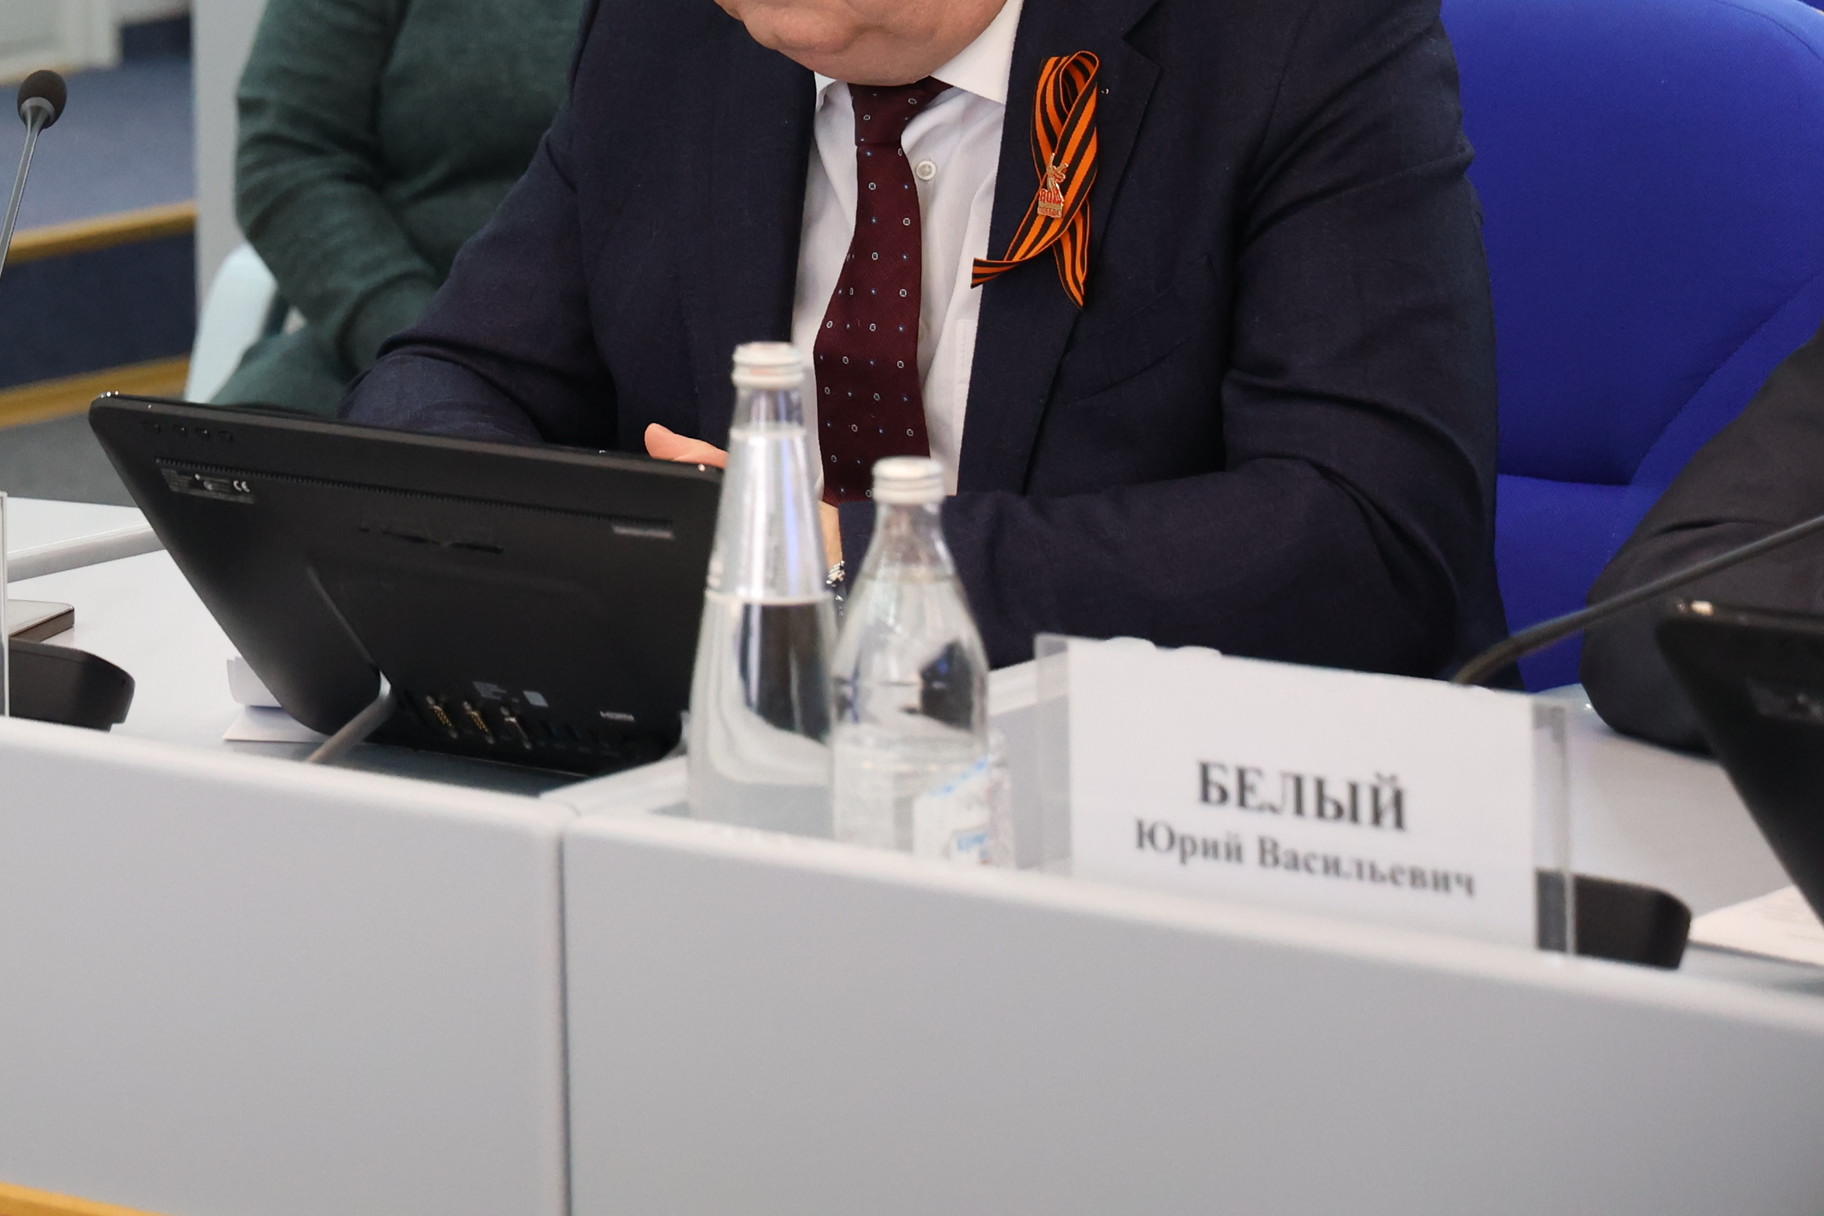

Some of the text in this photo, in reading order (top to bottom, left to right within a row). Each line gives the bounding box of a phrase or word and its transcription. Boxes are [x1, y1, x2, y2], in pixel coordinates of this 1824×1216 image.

[1197, 760, 1406, 832] БЕЛЫЙ
[1134, 819, 1476, 898] Юрий Васильевич
